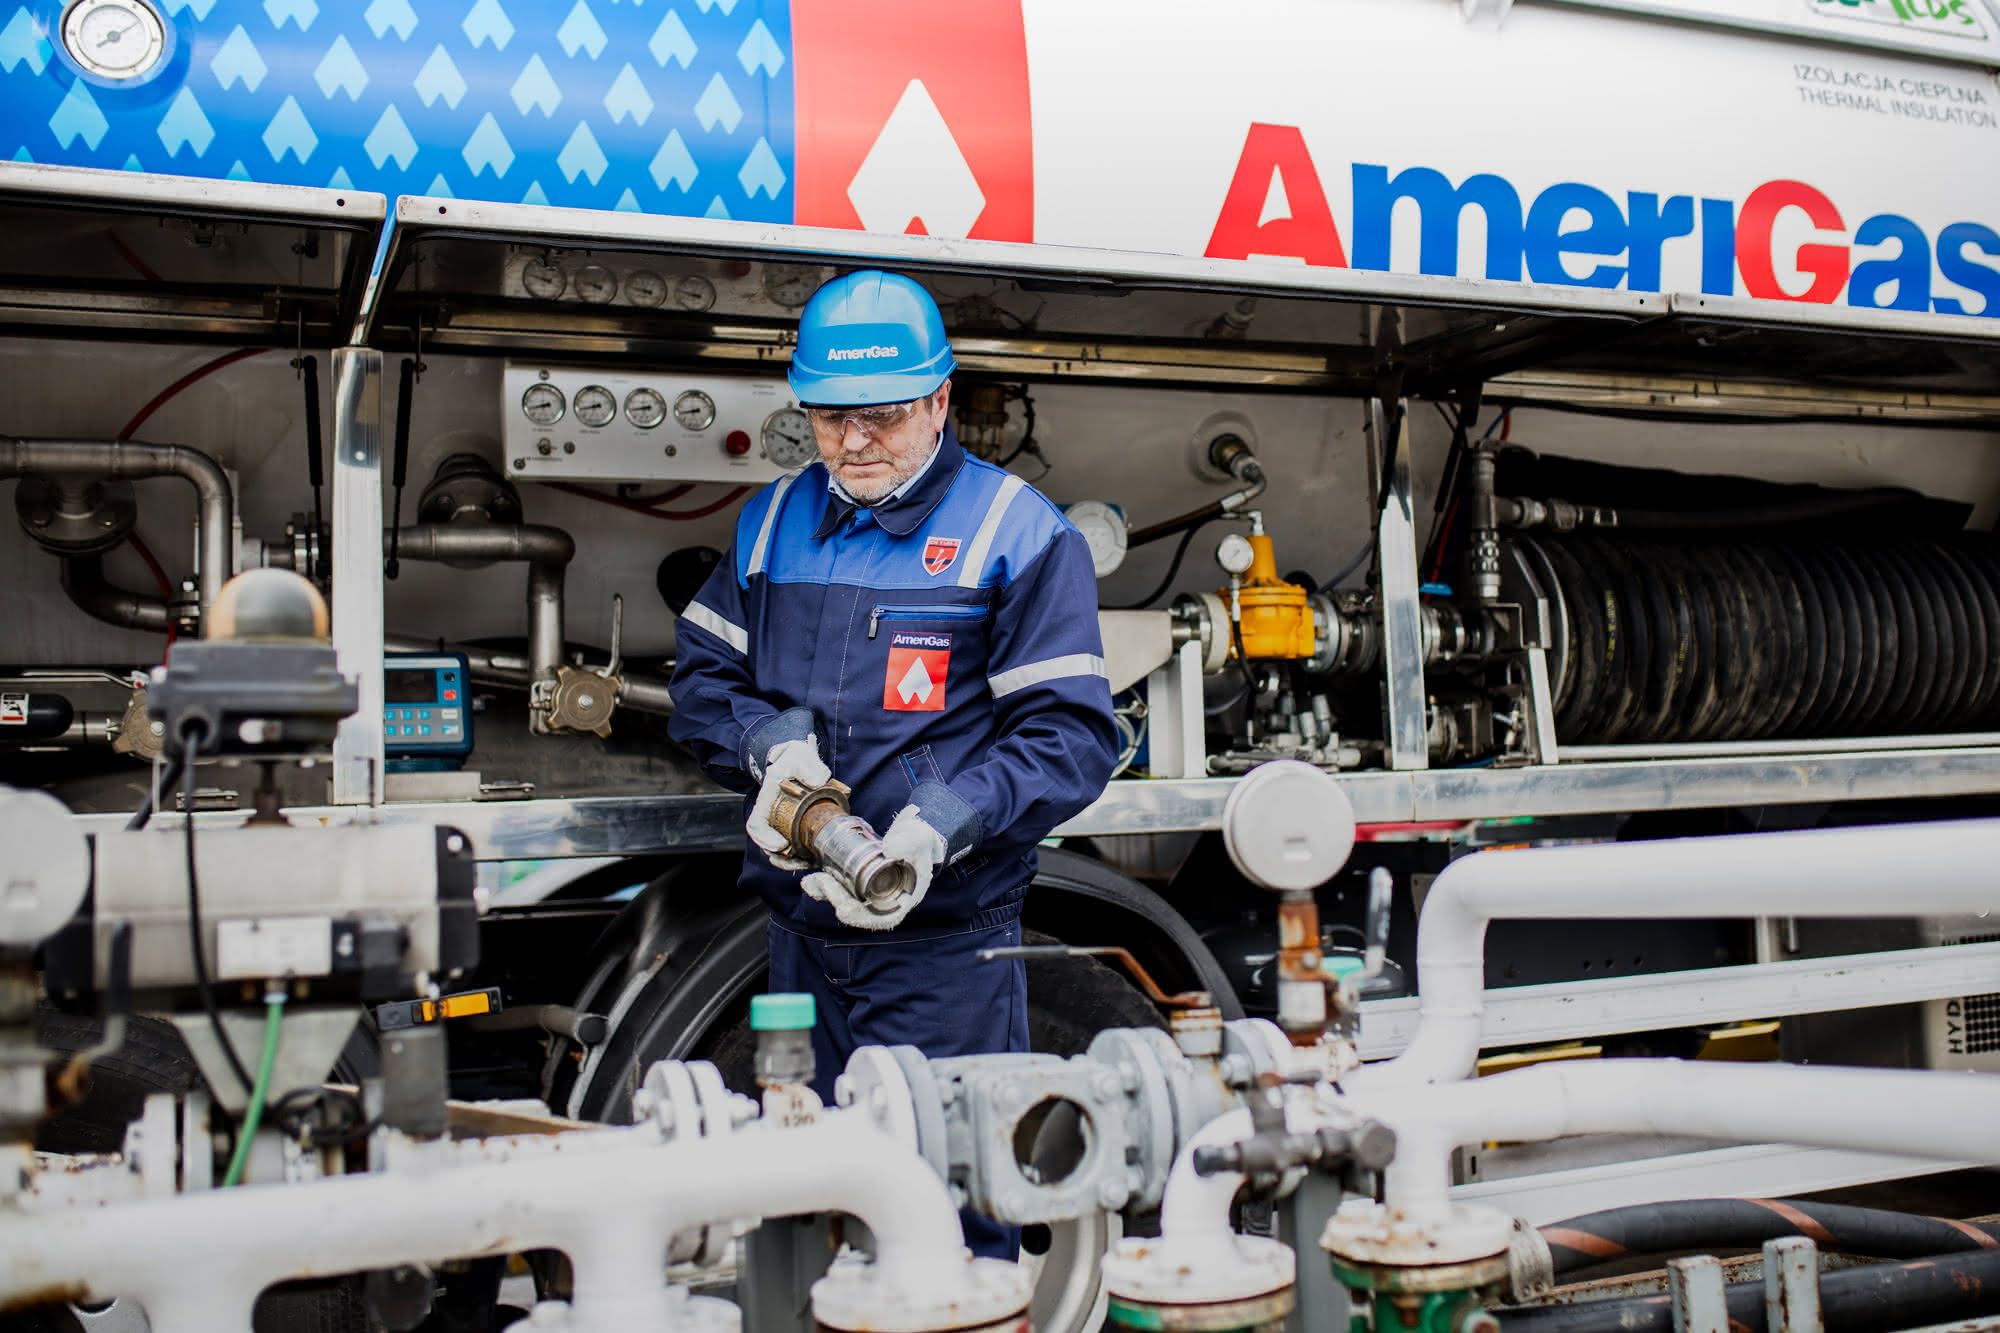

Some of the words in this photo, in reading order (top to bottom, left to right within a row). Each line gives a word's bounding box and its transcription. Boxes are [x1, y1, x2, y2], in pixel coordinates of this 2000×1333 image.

[1793, 63, 1896, 92] IZOLACJA
[1900, 79, 1987, 105] CIEPLNA
[1796, 86, 1888, 115] THERMAL
[1890, 100, 1998, 128] INSULATION
[1205, 122, 2000, 317] AmeriGas
[827, 345, 899, 360] AmeriGas
[893, 634, 950, 647] AmeriGas
